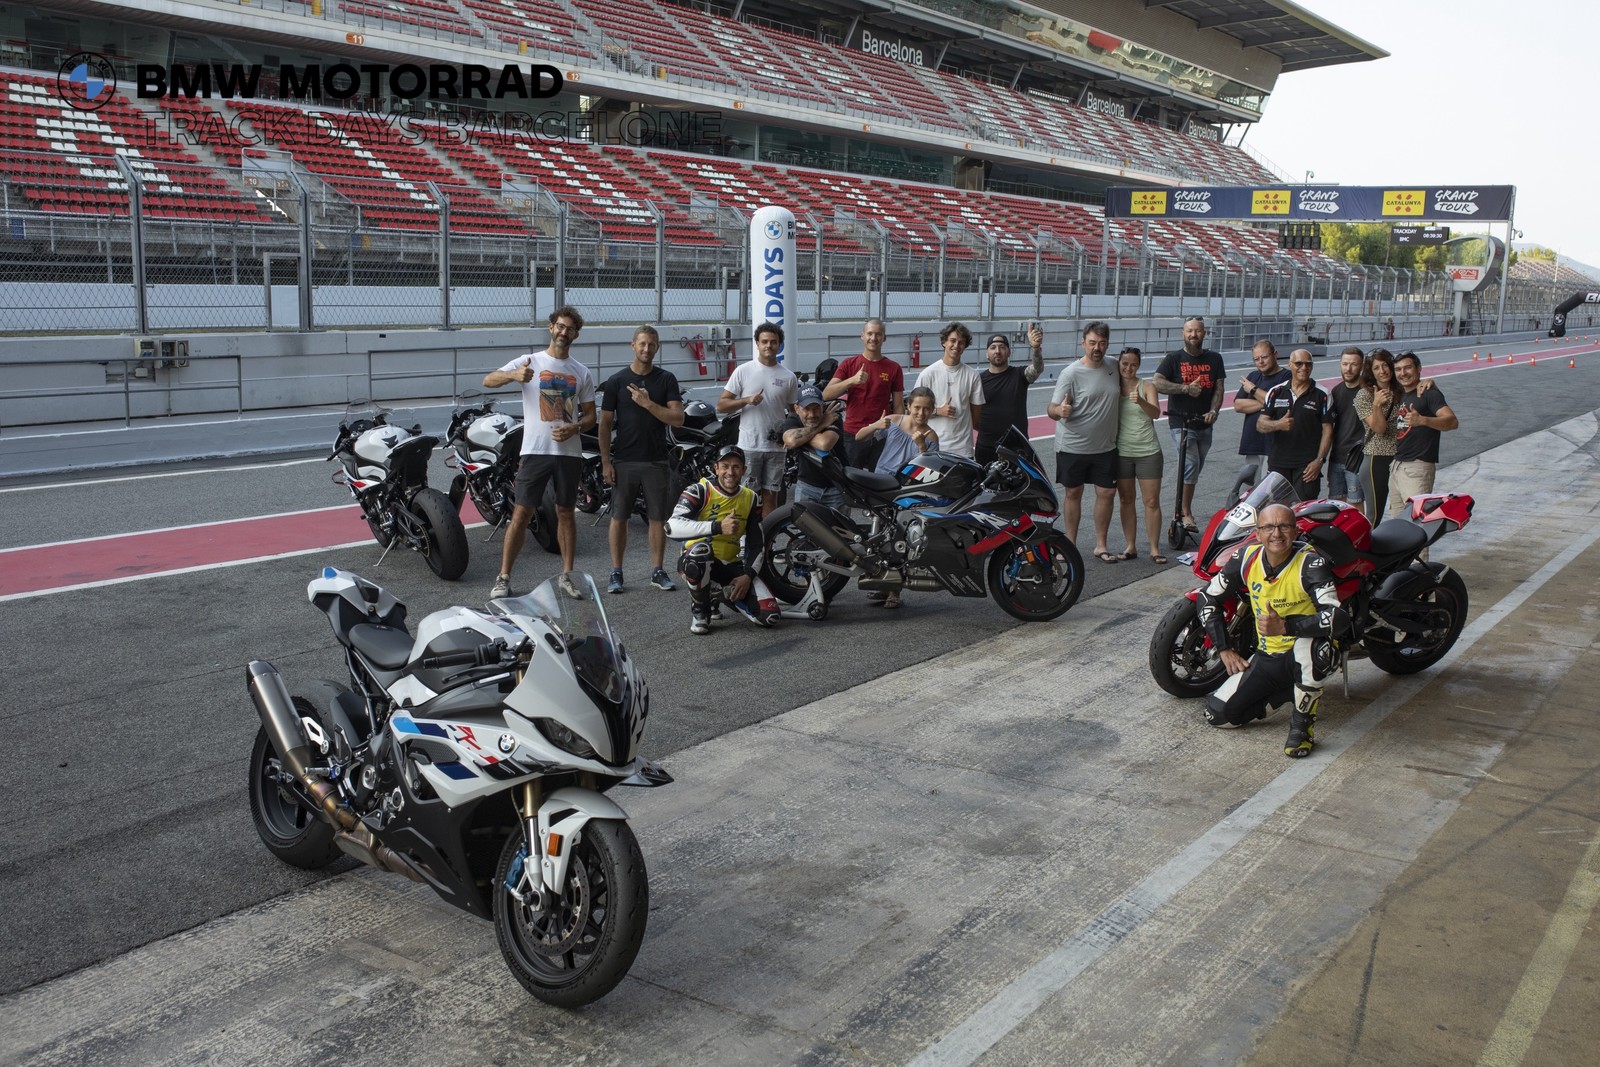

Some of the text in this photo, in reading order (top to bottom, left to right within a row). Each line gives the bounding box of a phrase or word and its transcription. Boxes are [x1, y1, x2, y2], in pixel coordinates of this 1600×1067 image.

[862, 29, 924, 67] Barcelona
[1086, 91, 1126, 118] Barcelona
[1188, 119, 1218, 142] Barcelona
[1174, 190, 1212, 202] GRAND
[1299, 189, 1340, 202] GRAND
[1434, 189, 1479, 202] GRAND
[1177, 202, 1205, 212] TOUR
[1302, 202, 1332, 212] TOUR
[1439, 202, 1471, 213] TOUR
[1180, 364, 1211, 373] BRAND
